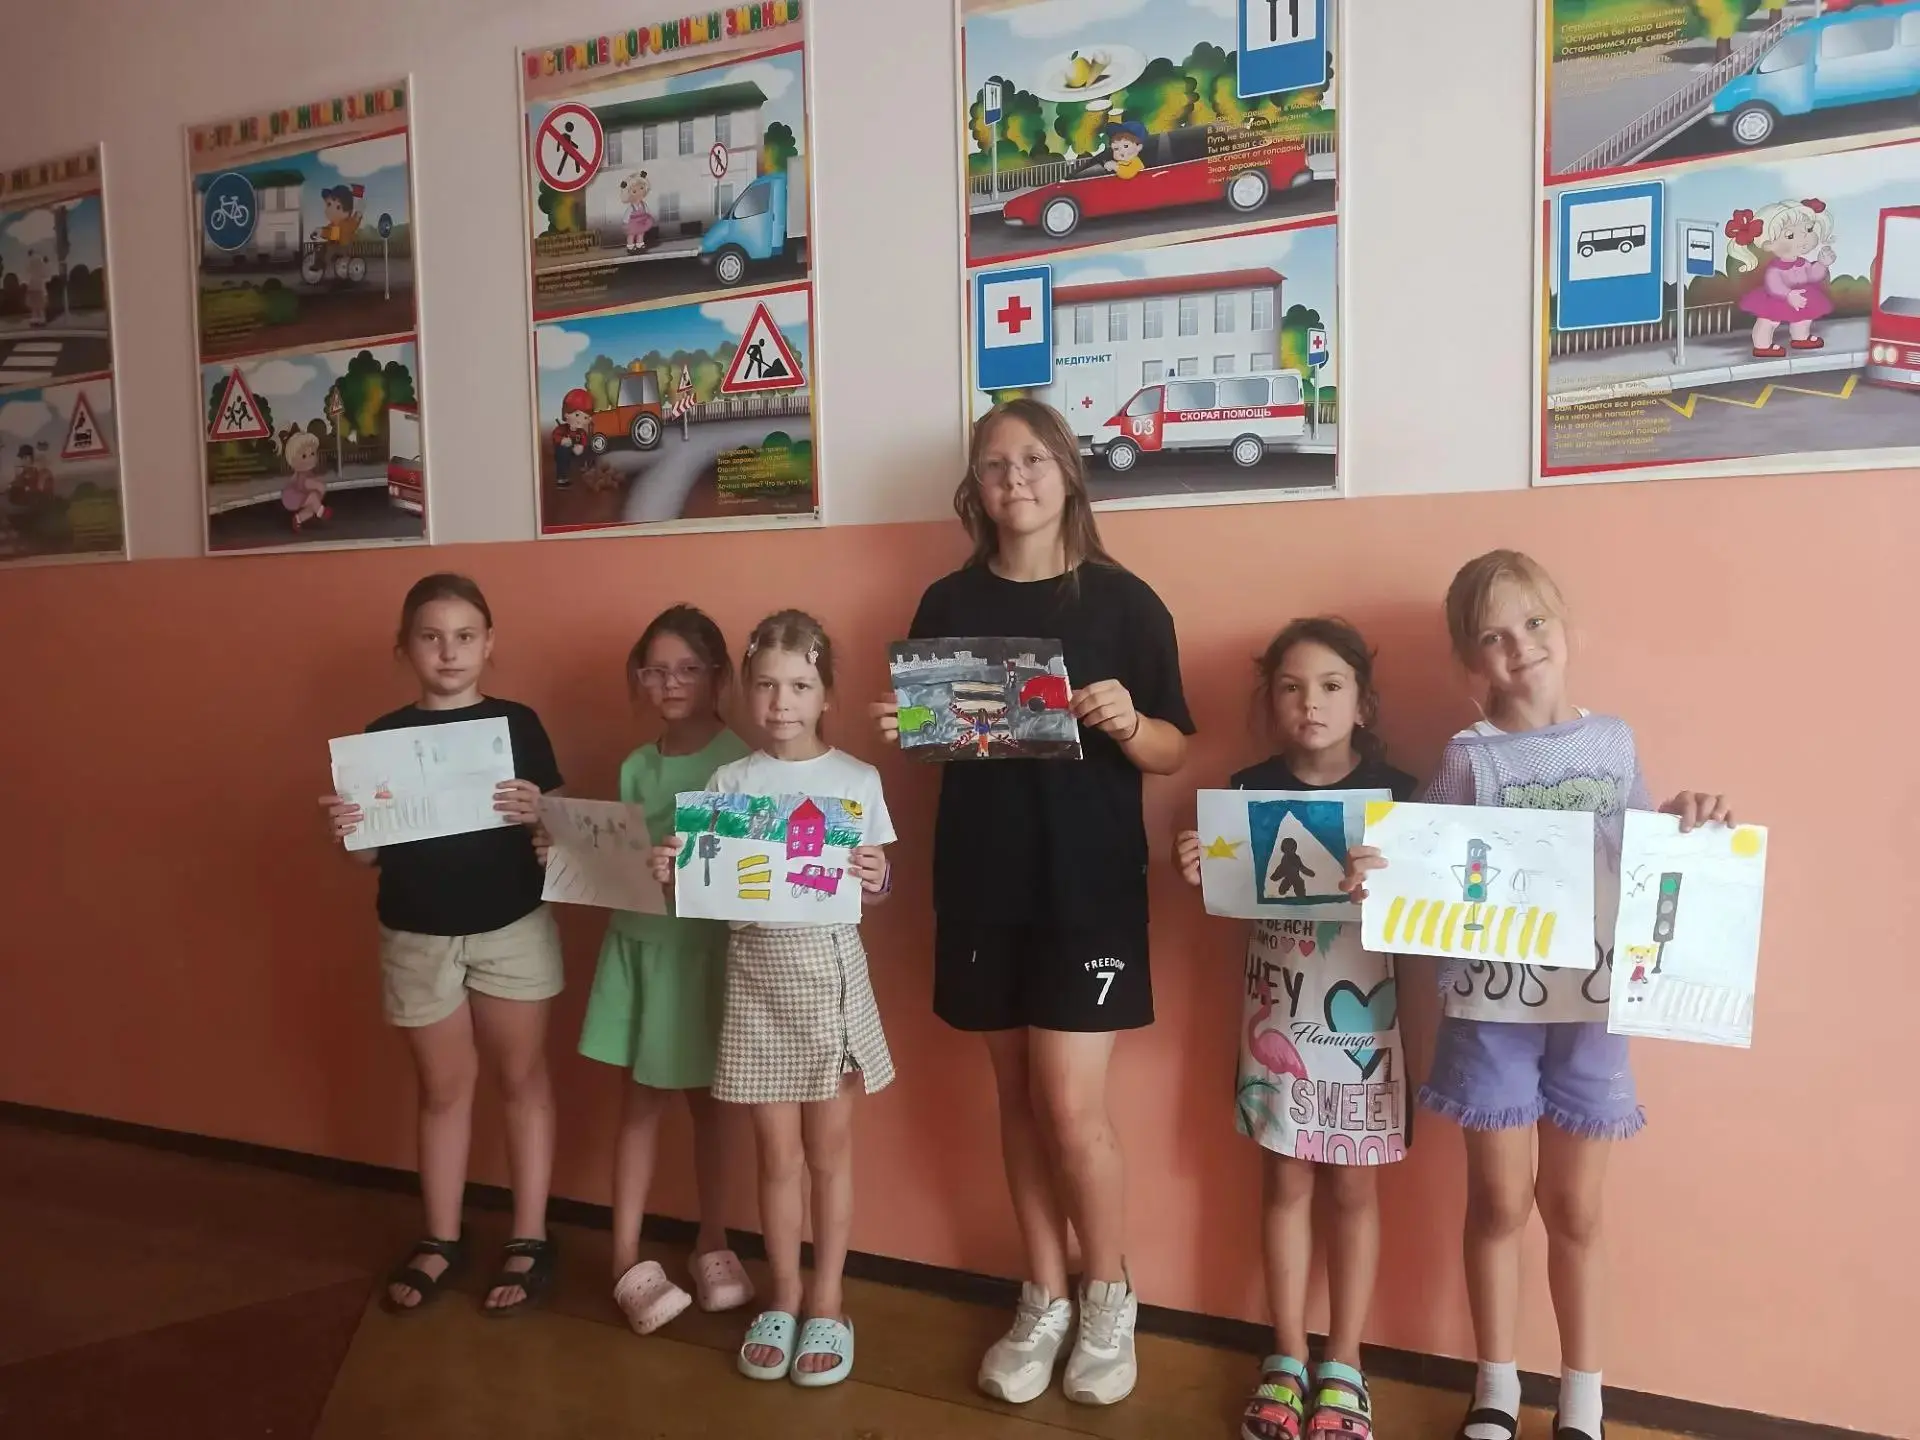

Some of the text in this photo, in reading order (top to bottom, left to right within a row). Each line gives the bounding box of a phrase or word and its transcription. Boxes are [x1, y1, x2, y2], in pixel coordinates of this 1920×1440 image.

[543, 34, 611, 77] СТРАНЕ
[613, 9, 721, 68] ДОРОЖНЫХ
[1207, 146, 1218, 154] Ты
[1056, 354, 1112, 366] МЕДПУНКТ
[1132, 419, 1155, 436] 03
[1180, 409, 1272, 421] СКОРАЯ ПОМОЩЬ
[1084, 958, 1125, 971] FREEDOM
[1096, 972, 1115, 1005] 7
[1247, 954, 1304, 1017] HEY
[1290, 1022, 1377, 1061] Flamingo
[1290, 1078, 1399, 1131] SWEET
